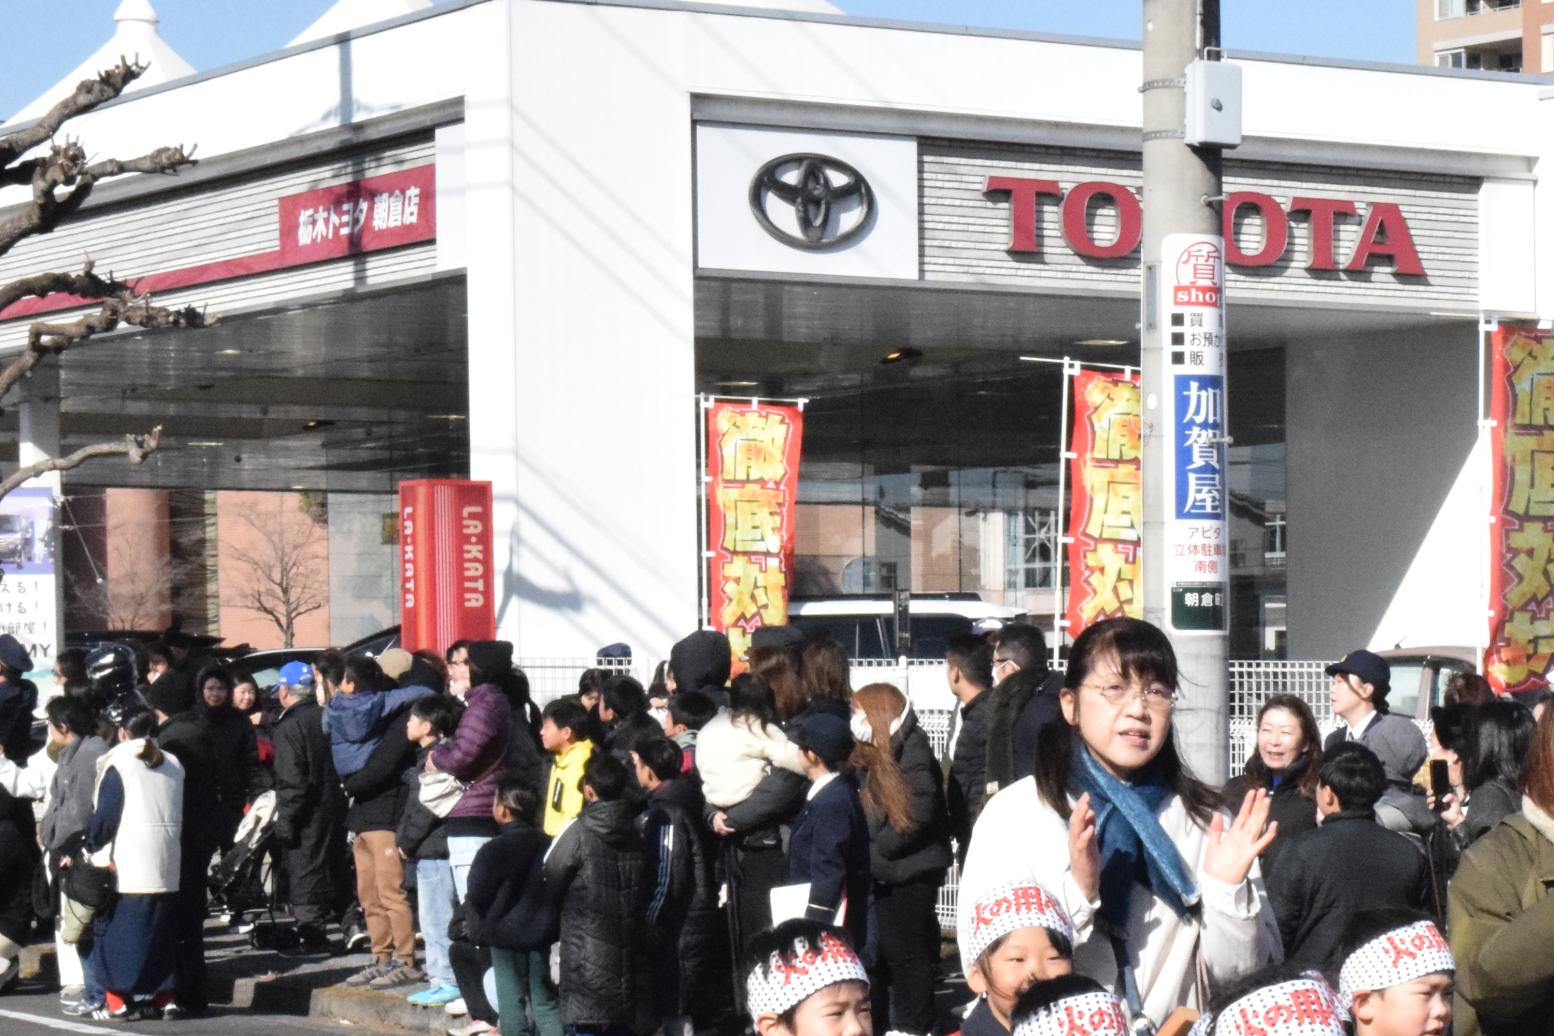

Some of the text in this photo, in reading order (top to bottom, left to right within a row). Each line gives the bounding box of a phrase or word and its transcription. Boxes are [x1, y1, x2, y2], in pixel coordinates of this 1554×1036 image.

[298, 186, 420, 246] 栃木トヨタ 朝倉店
[983, 175, 1428, 276] TOOTA
[1182, 380, 1221, 514] 加賀屋
[1174, 544, 1226, 557] 立体駐車
[1194, 560, 1218, 574] 南側
